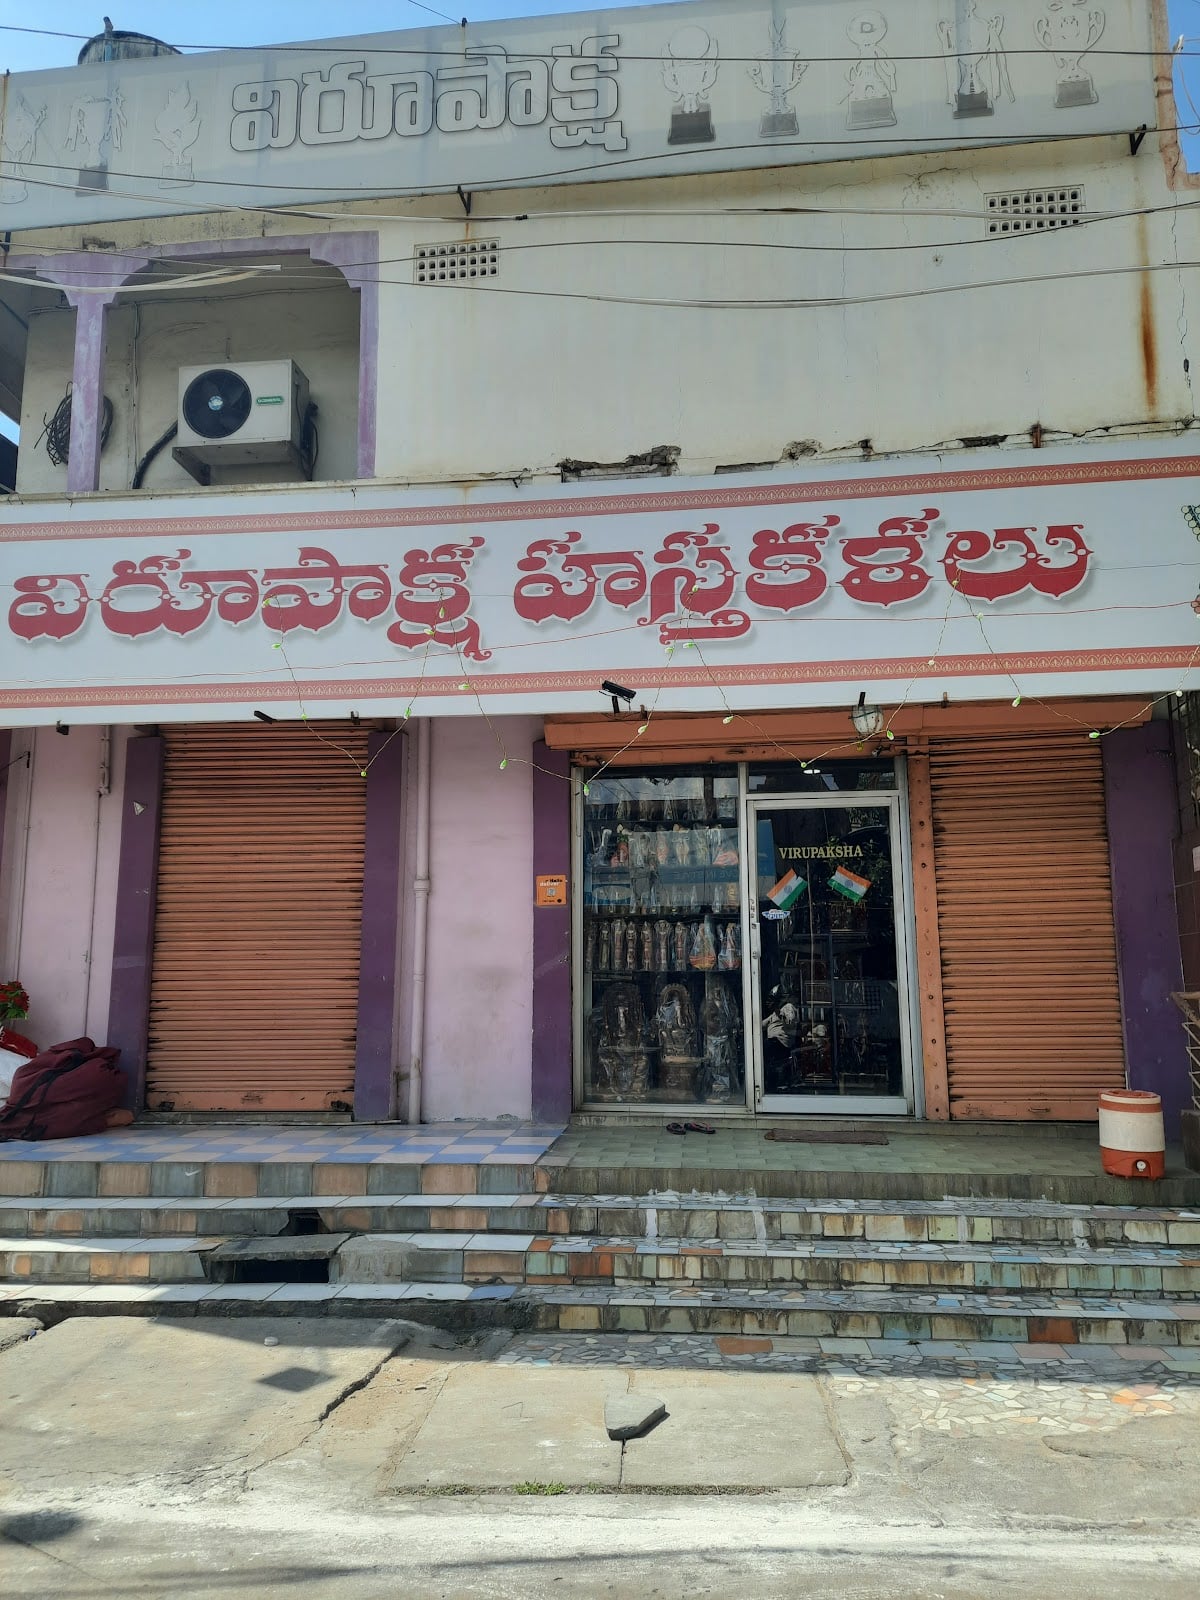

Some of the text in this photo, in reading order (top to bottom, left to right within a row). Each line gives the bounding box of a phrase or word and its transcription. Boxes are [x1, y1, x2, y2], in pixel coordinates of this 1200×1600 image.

[230, 34, 628, 151] విరూపాక్ష
[8, 508, 1094, 661] విరూపాక్ష హస్తకళలు
[778, 844, 864, 860] VIRUPAKSHA
